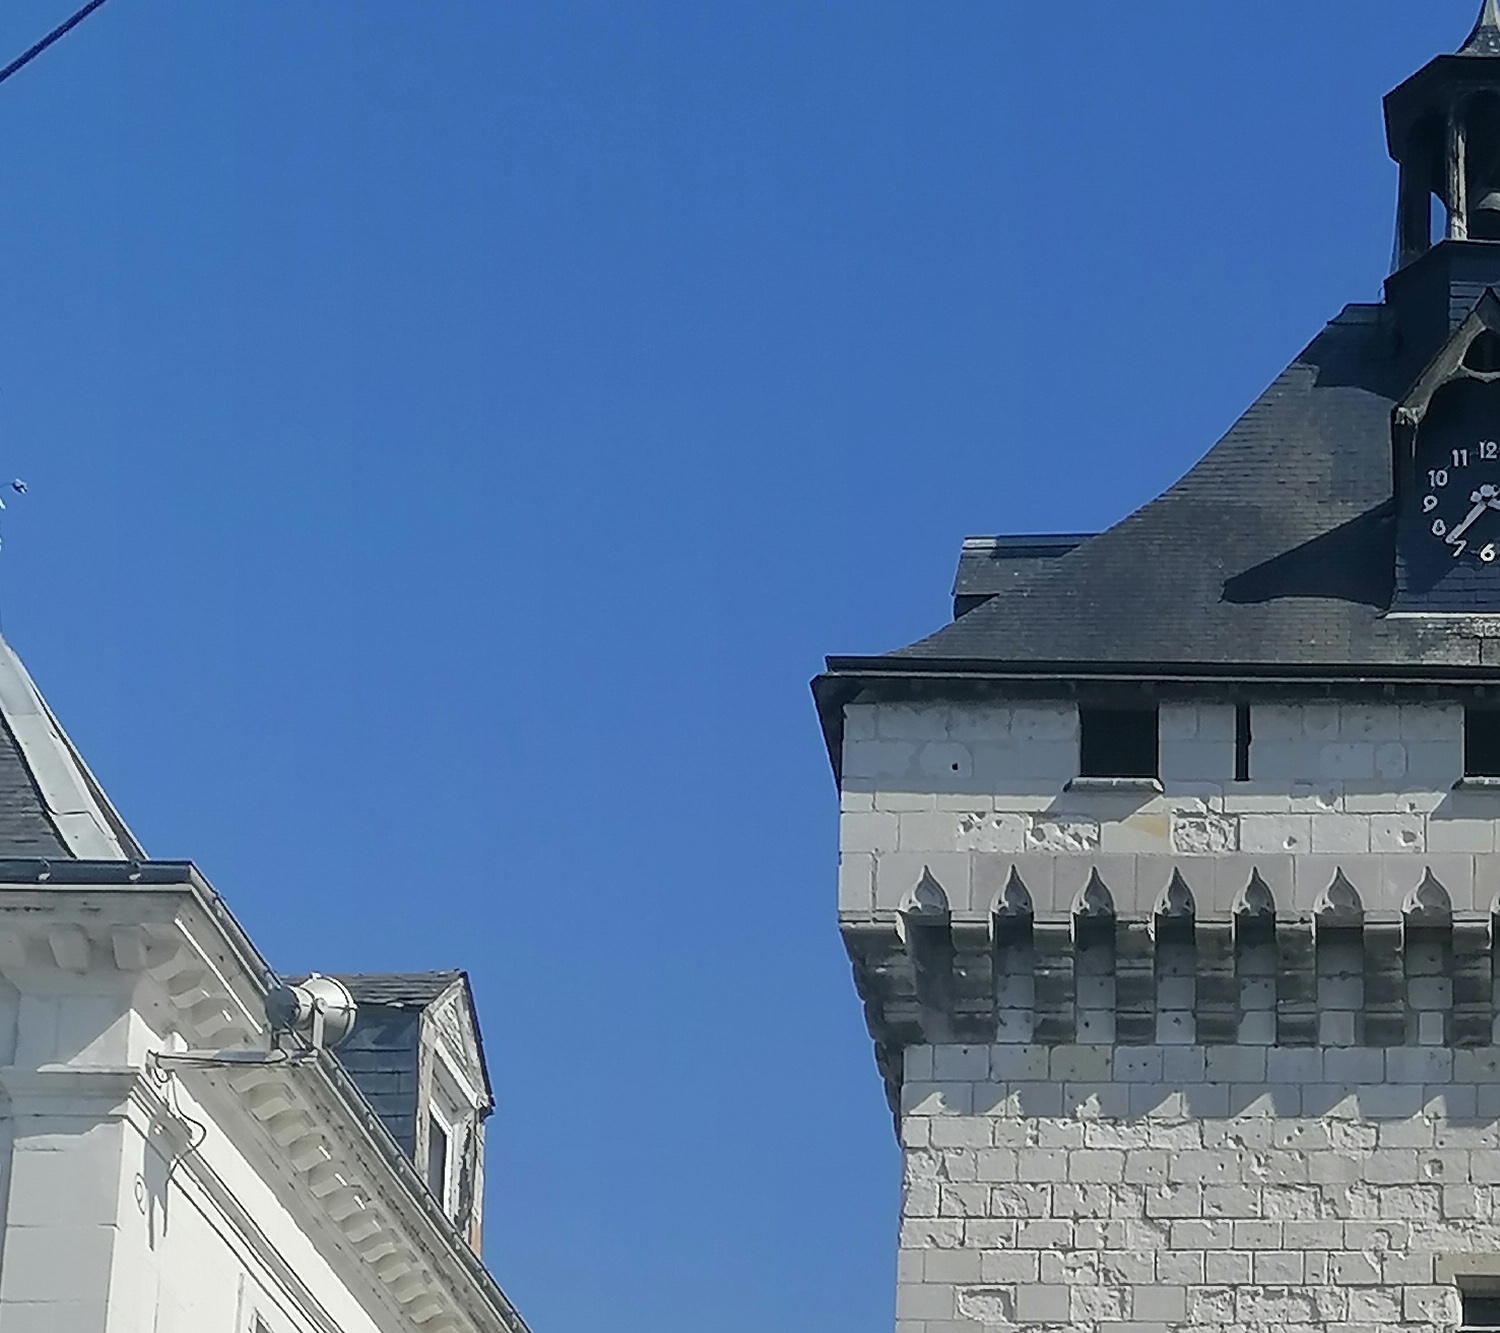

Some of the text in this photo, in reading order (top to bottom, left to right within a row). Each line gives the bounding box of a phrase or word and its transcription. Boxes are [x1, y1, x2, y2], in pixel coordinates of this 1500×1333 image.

[1452, 449, 1468, 466] 11
[1479, 441, 1498, 459] 12
[1428, 470, 1447, 487] 10
[1423, 495, 1438, 513] 9
[1480, 543, 1495, 562] 6
